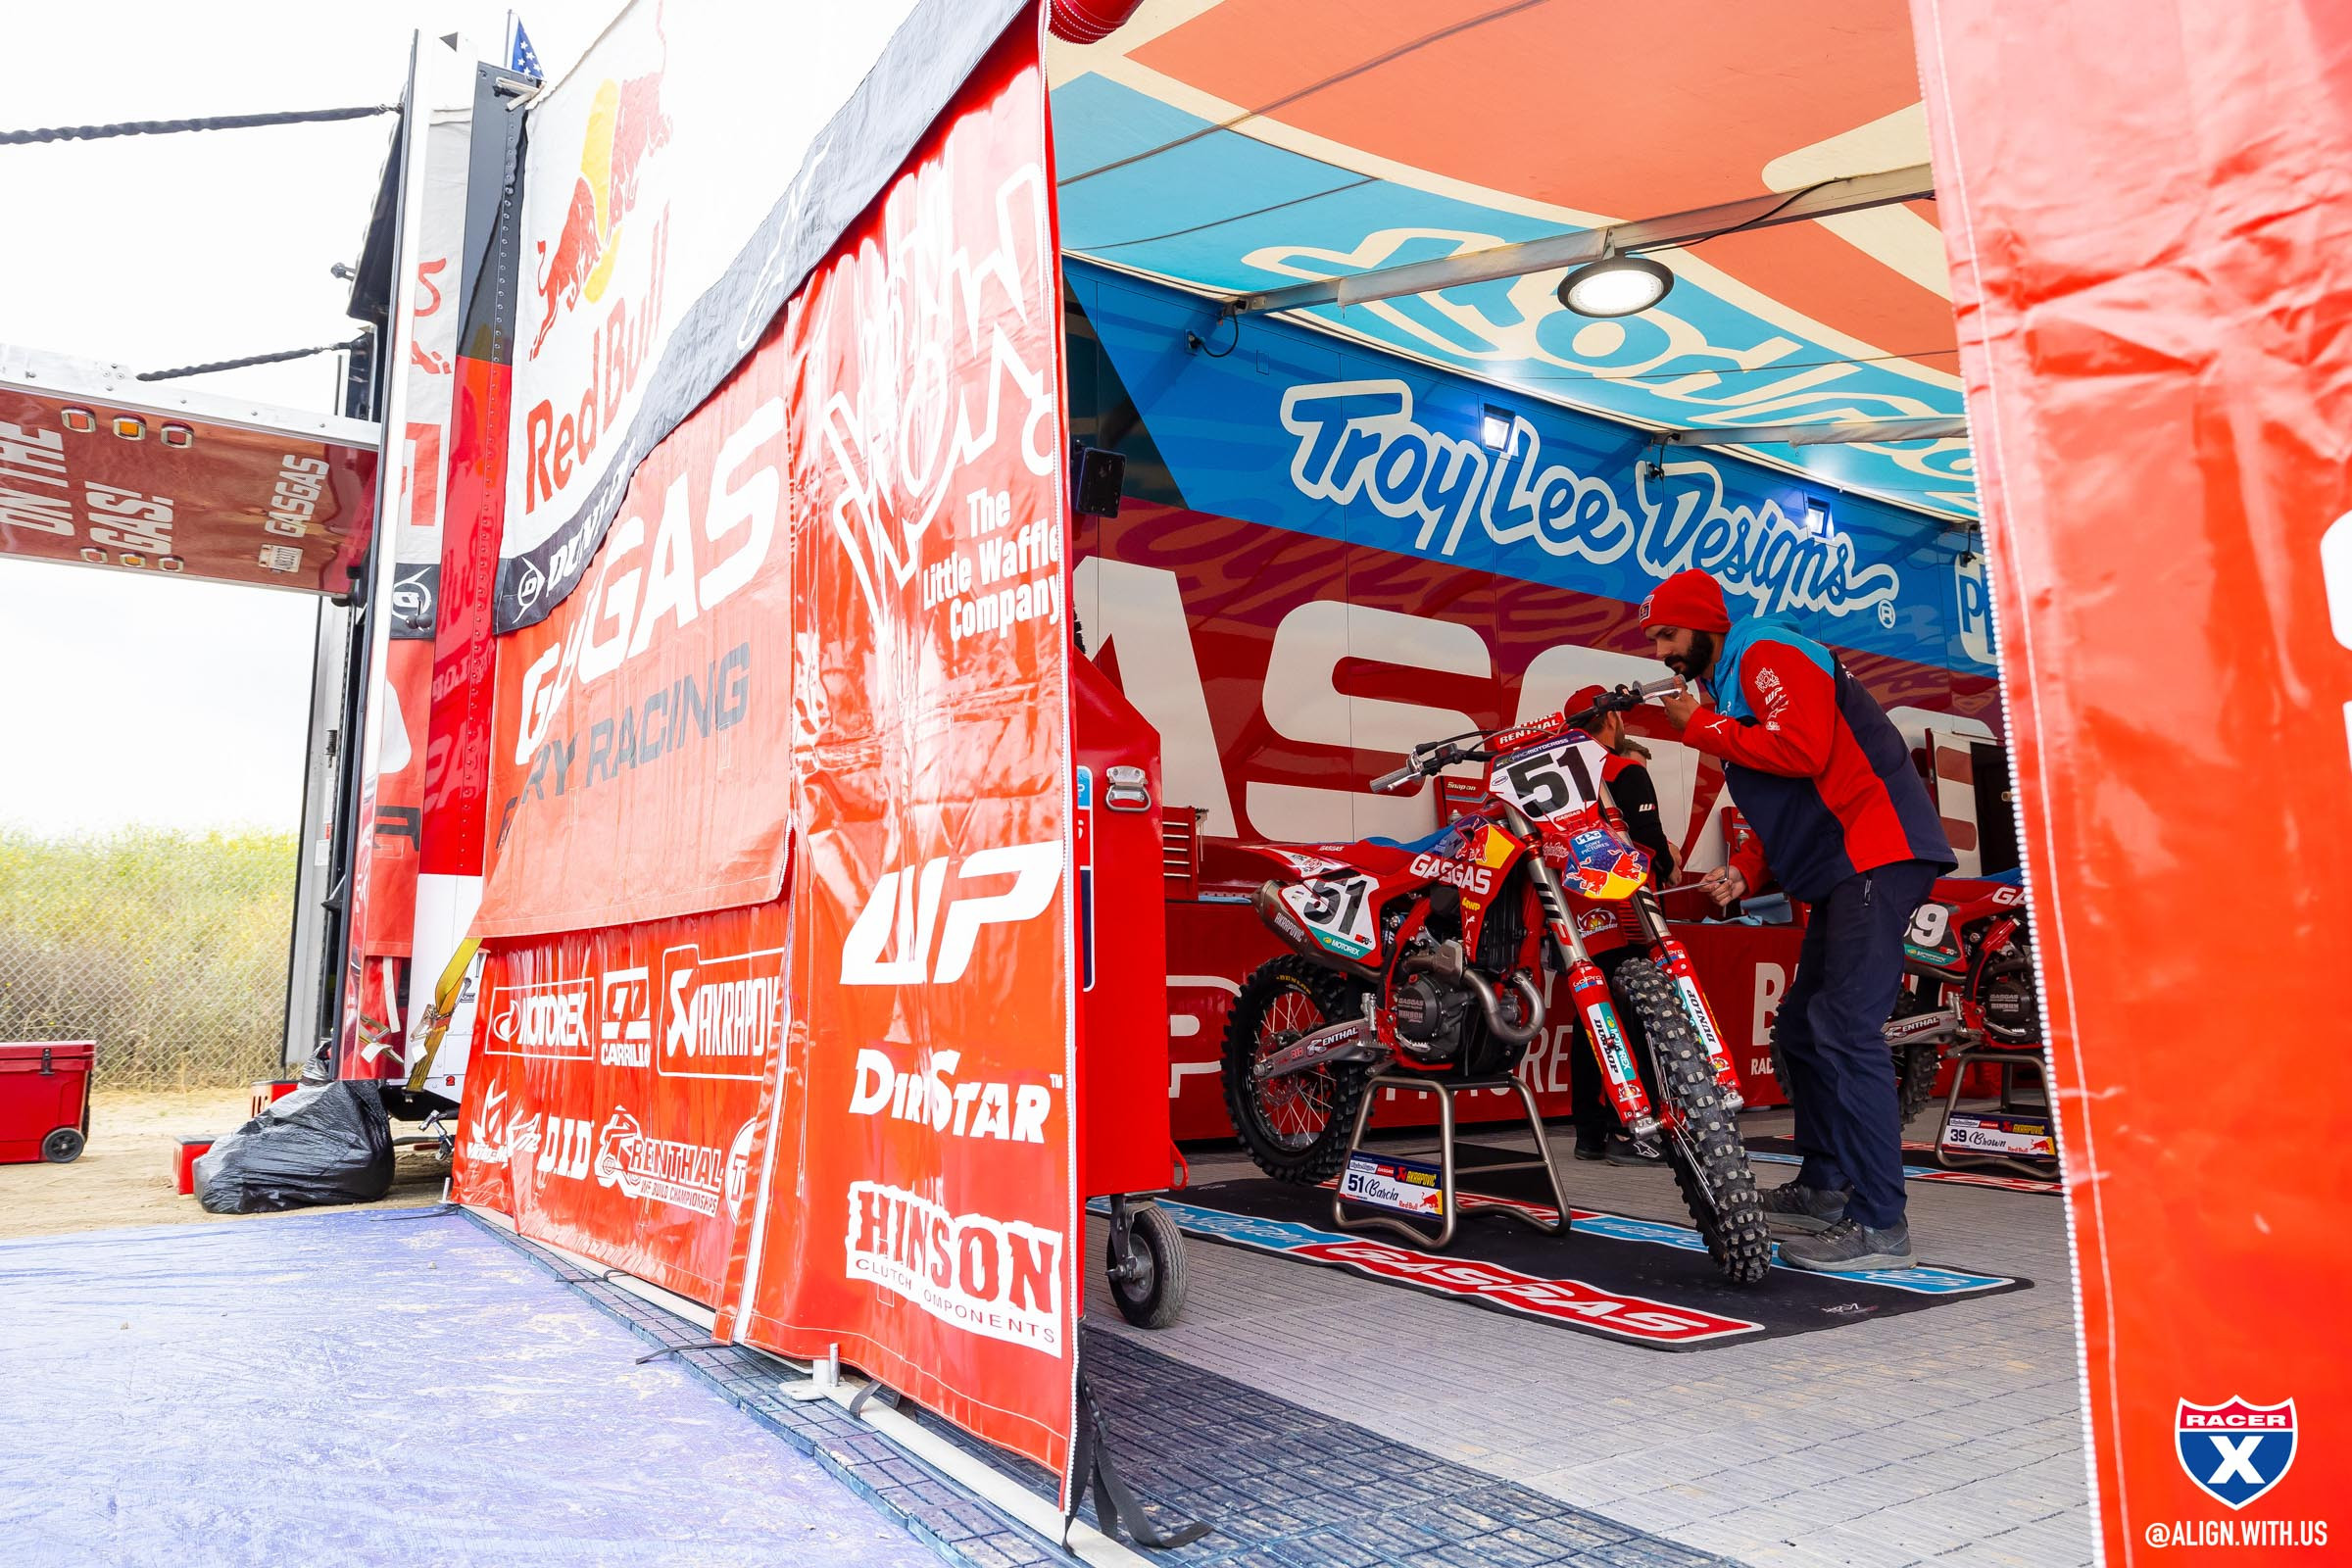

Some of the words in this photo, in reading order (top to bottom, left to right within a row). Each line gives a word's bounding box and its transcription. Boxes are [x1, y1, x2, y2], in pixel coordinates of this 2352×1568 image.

[525, 328, 601, 515] Red
[85, 481, 174, 555] GAS!
[265, 454, 329, 538] GASGAS
[966, 487, 1010, 538] The
[1281, 379, 1488, 556] Troy
[1482, 416, 1638, 565] Lee
[1635, 461, 1899, 617] Designs
[923, 551, 972, 611] Little
[978, 517, 1058, 585] Waffle
[950, 573, 1059, 642] Company
[586, 640, 751, 789] RACING
[1499, 719, 1560, 744] RENTHAL
[1506, 745, 1597, 817] 51
[1409, 854, 1492, 895] GASGAS
[840, 839, 1063, 986] WP
[1303, 879, 1368, 936] 51
[1904, 903, 1949, 948] 9
[1331, 939, 1361, 956] MOTOREX
[1573, 975, 1602, 988] GoPro
[516, 991, 589, 1047] MOTOREX
[698, 975, 783, 1056] AKRAPOV
[1686, 989, 1717, 1043] DUNLOP
[601, 1043, 650, 1068] CARRILLO
[630, 1137, 723, 1193] RENTHAL
[1950, 1129, 1967, 1142] 39
[1969, 1131, 2007, 1148] Brown
[652, 1182, 668, 1200] BUILD
[1348, 1173, 1365, 1194] 51
[1365, 1178, 1399, 1200] Barcia
[856, 1189, 1054, 1313] HINSON
[855, 1258, 911, 1290] CLUTCH
[921, 1289, 1055, 1345] OMPONENTS
[1325, 1246, 1710, 1333] GASGAS
